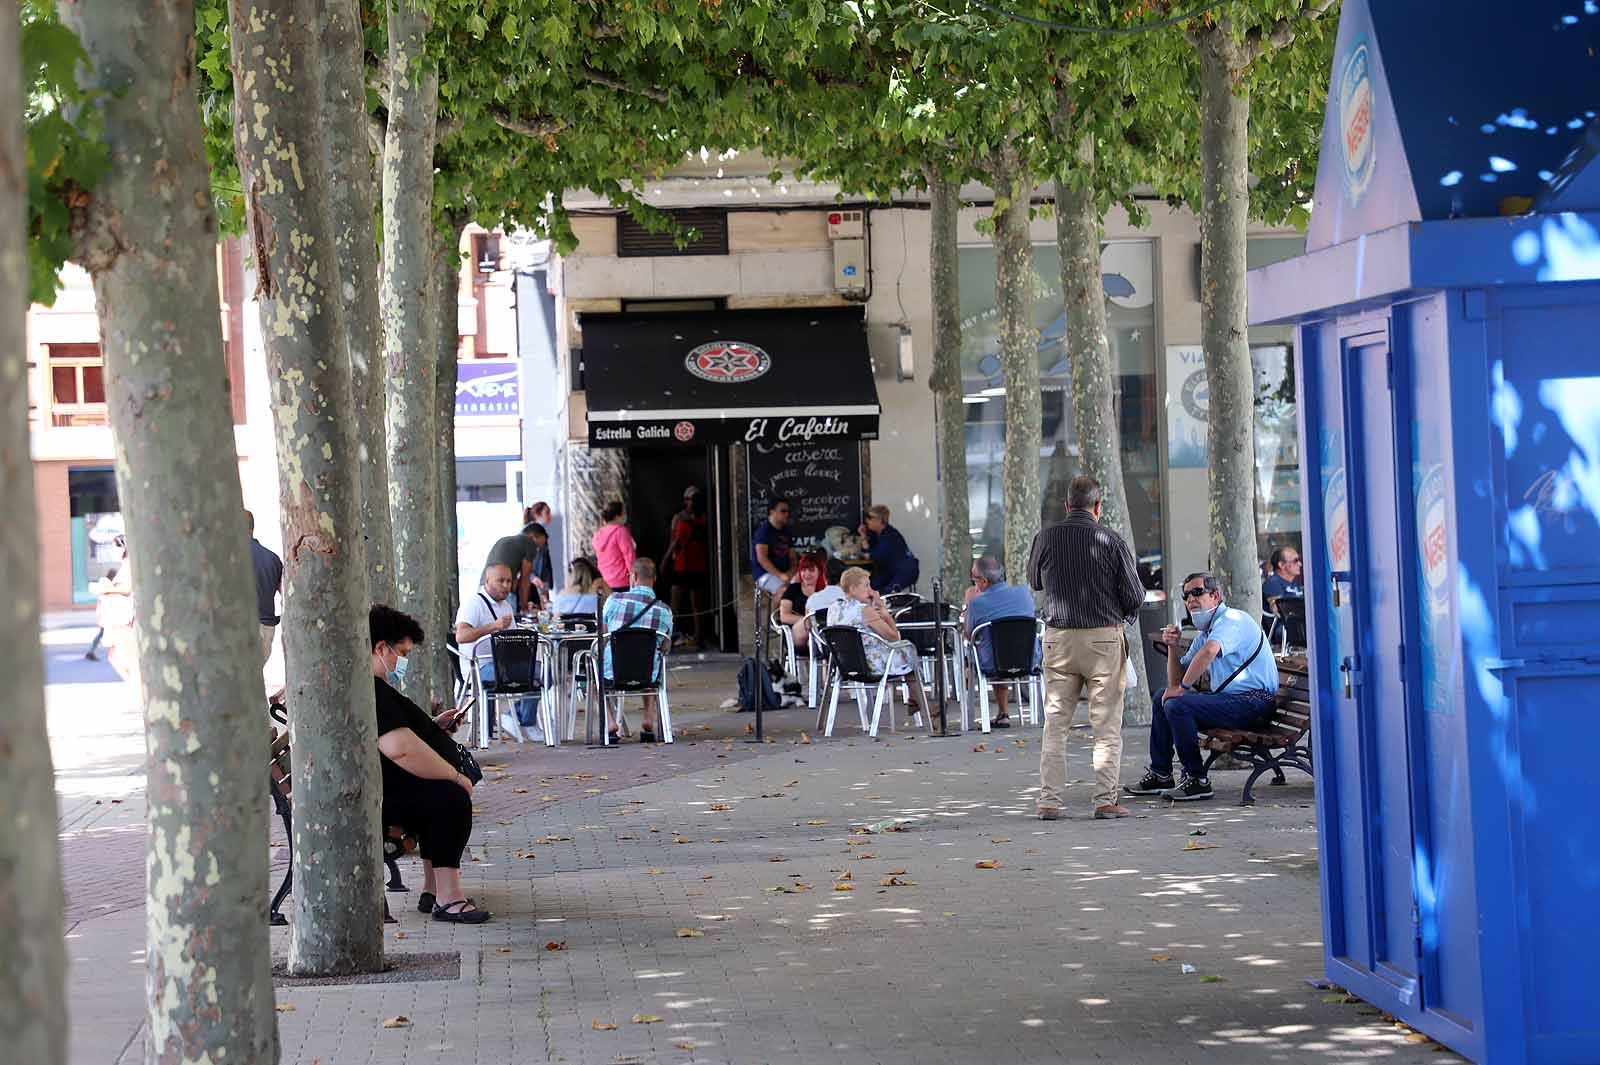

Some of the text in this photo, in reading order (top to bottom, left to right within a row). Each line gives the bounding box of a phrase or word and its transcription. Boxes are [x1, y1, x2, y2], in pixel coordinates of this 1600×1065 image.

[595, 425, 671, 440] Estrella Galicia
[744, 418, 769, 442] El
